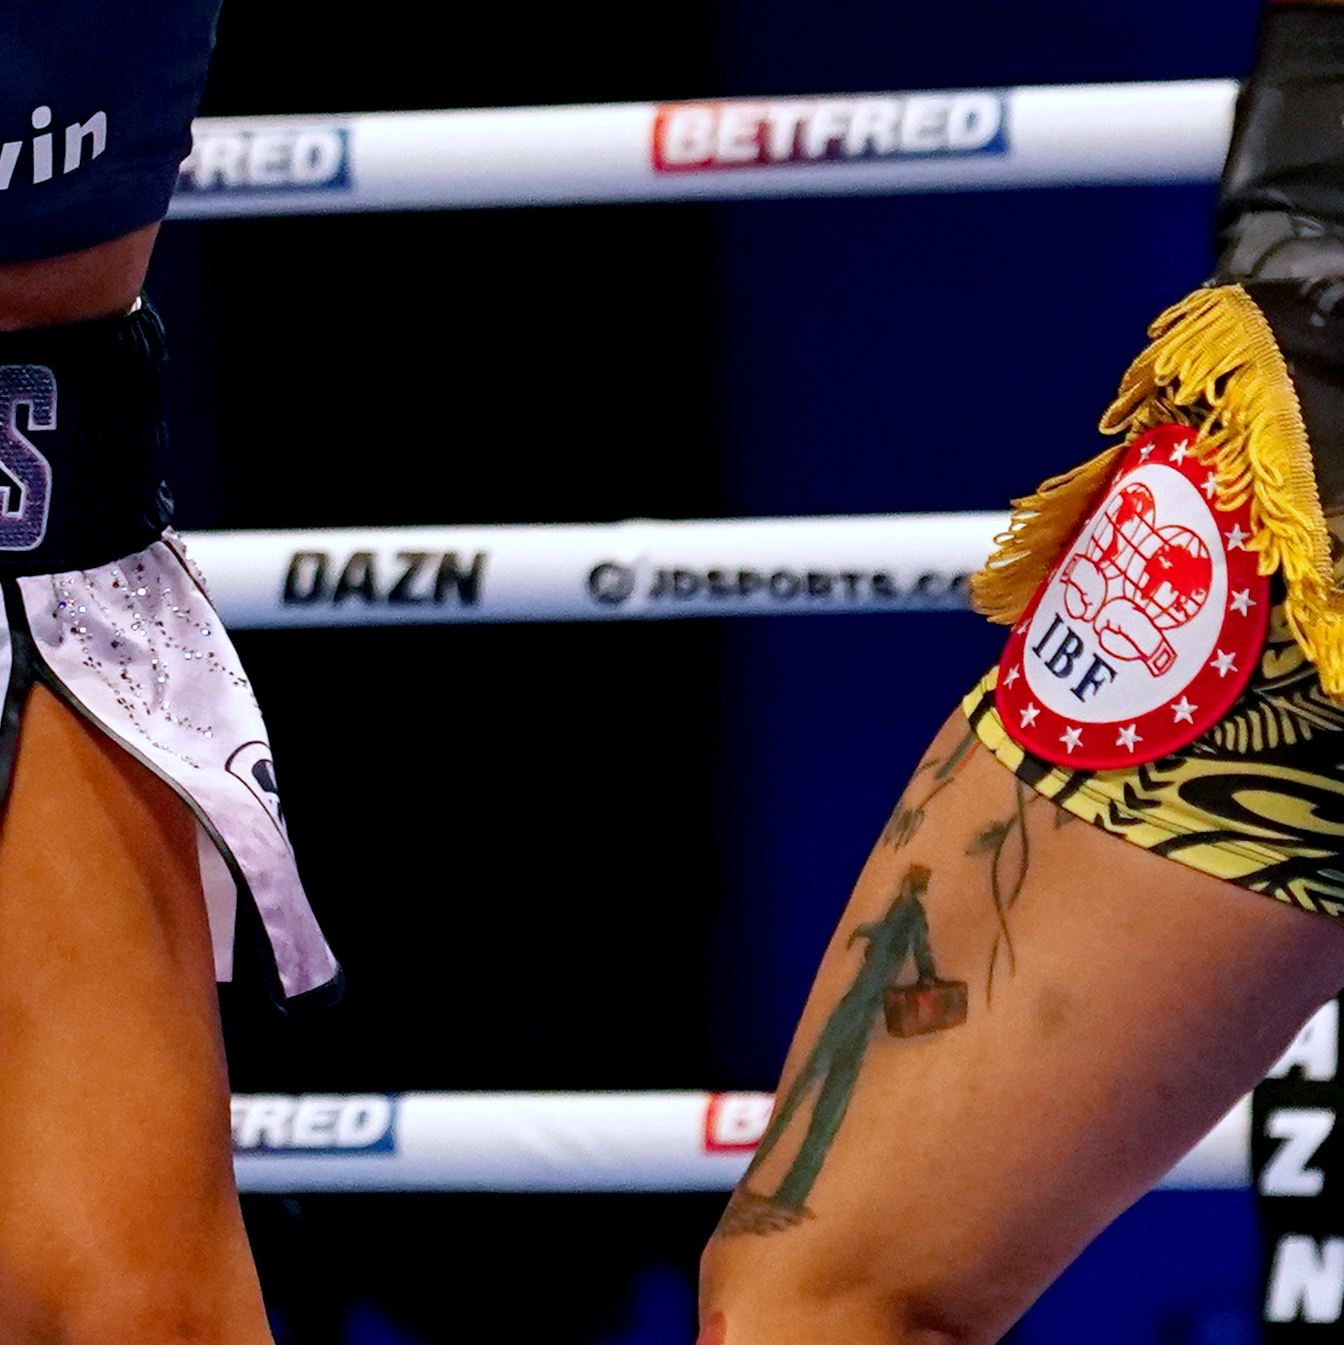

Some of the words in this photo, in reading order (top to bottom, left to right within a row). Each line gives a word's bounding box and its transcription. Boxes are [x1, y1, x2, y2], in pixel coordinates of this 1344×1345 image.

[662, 93, 1003, 167] BETFRED
[279, 549, 488, 608] DAZN
[1031, 614, 1117, 704] IBF
